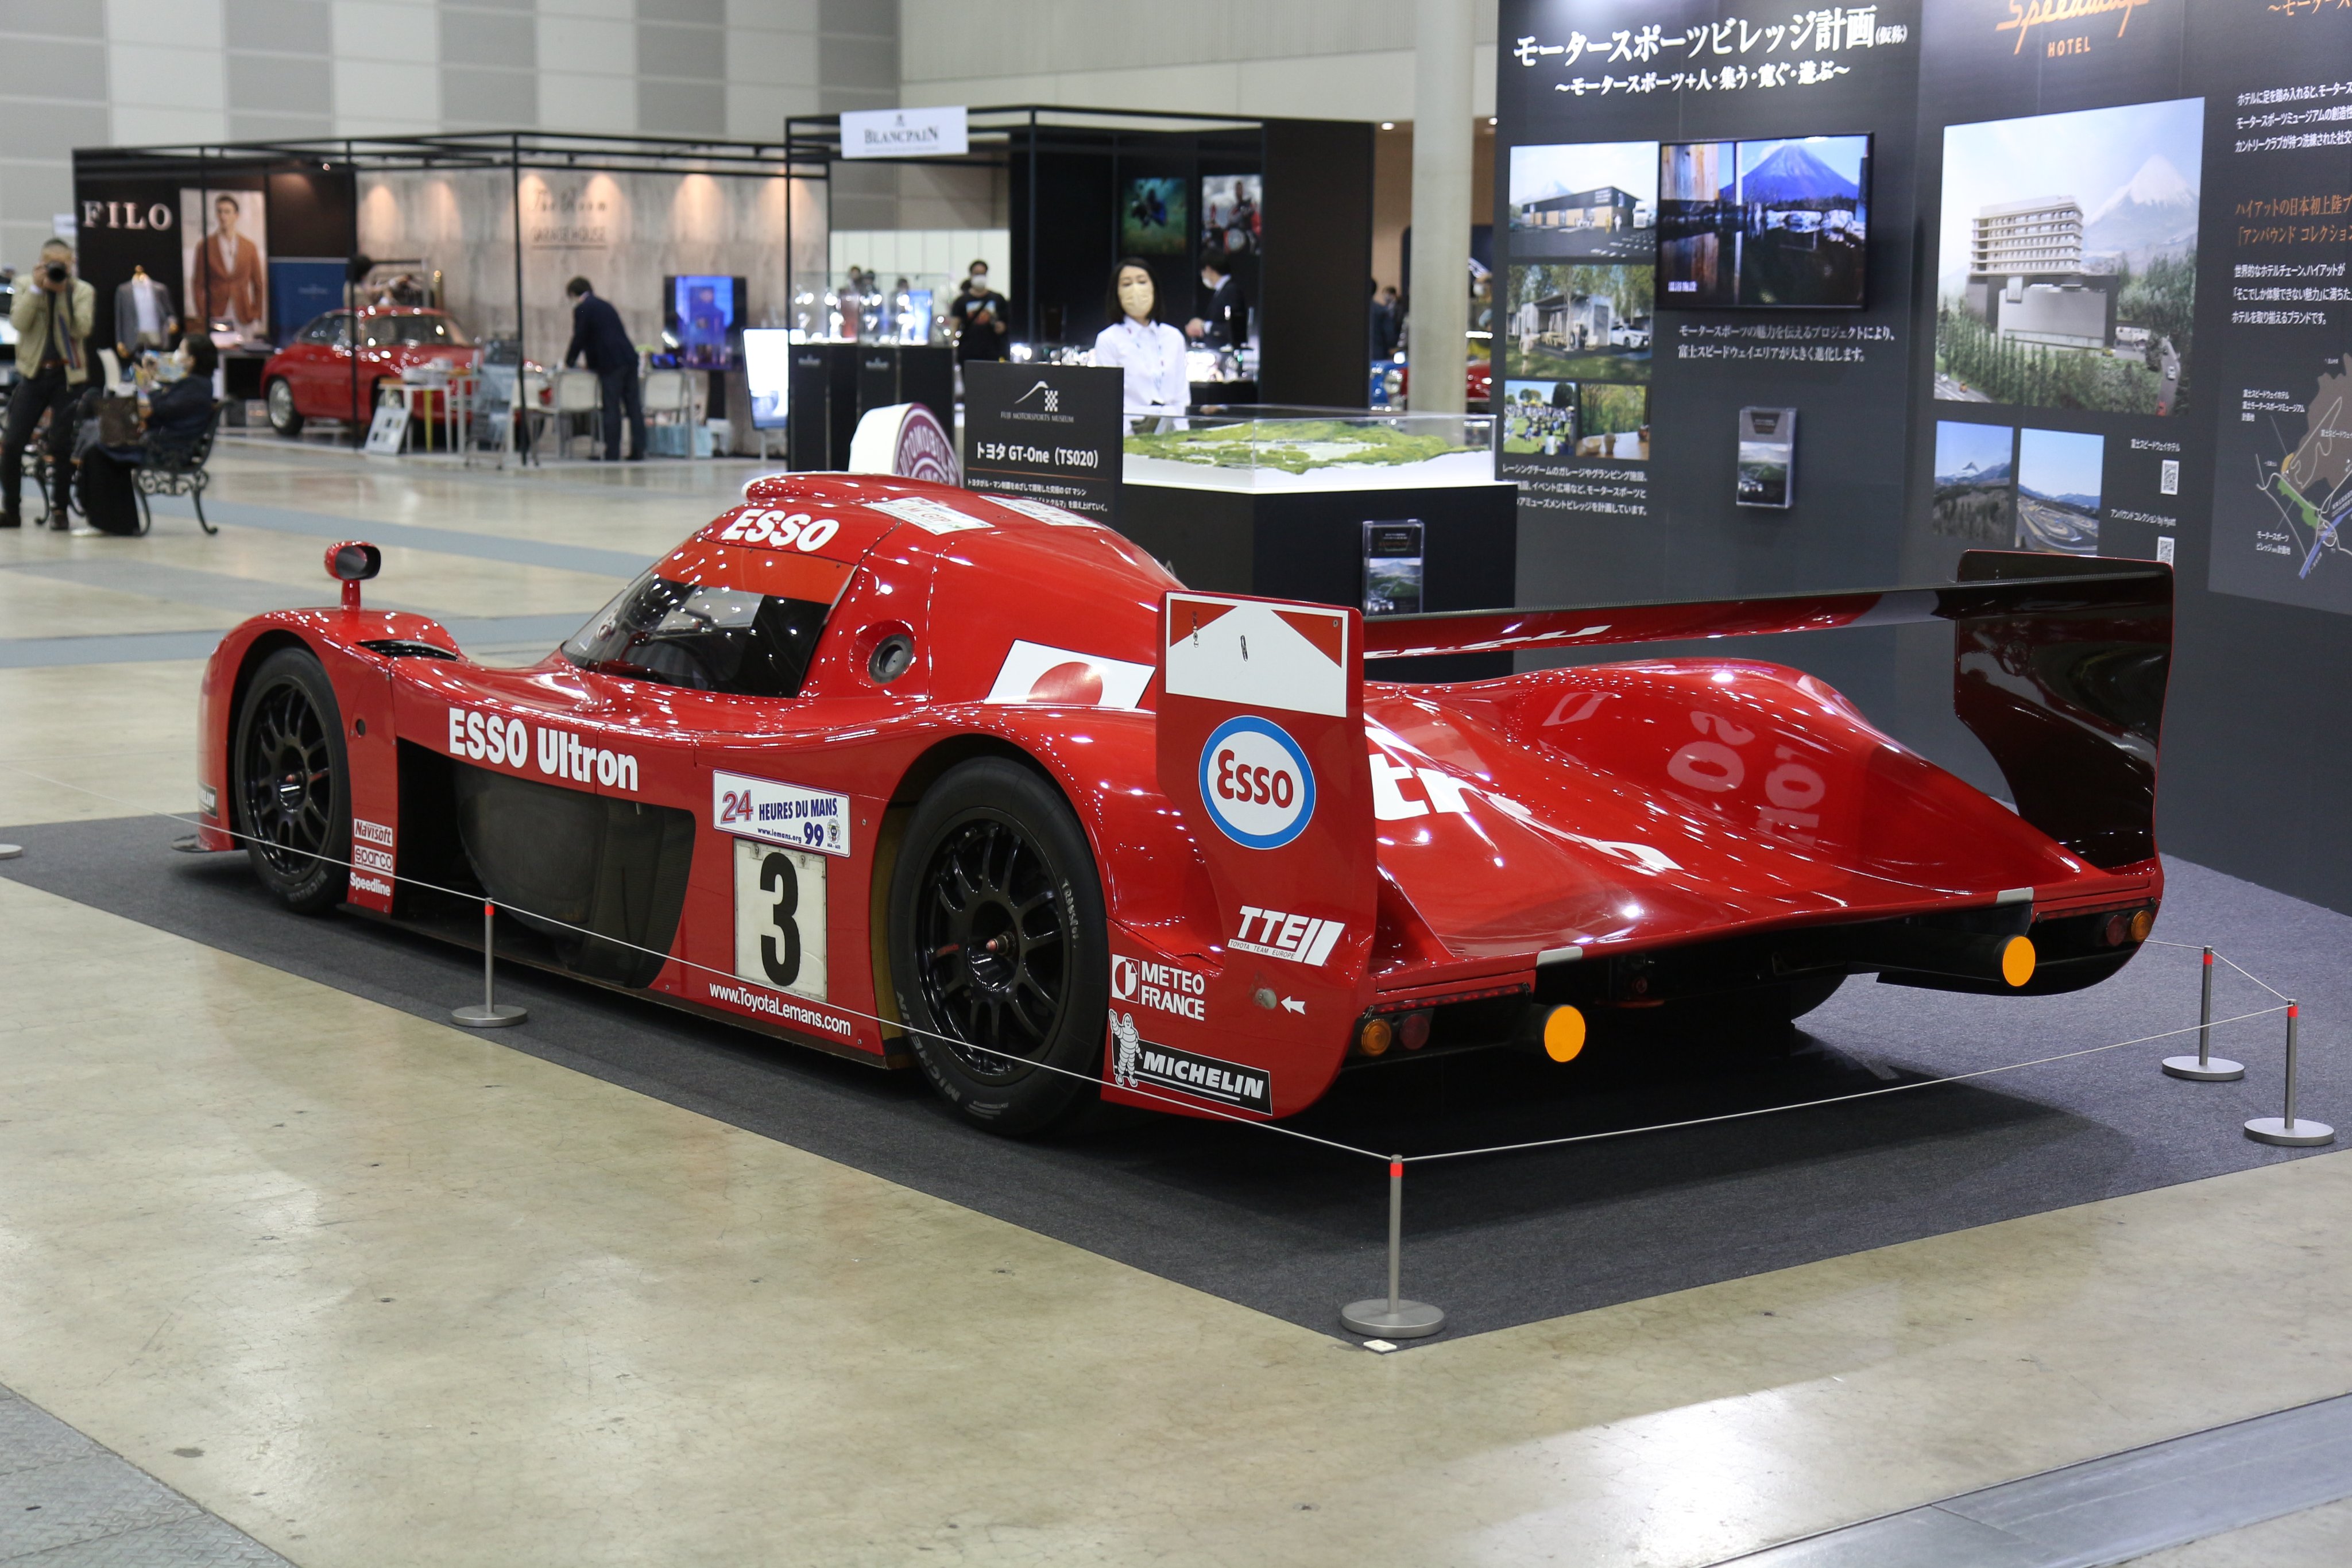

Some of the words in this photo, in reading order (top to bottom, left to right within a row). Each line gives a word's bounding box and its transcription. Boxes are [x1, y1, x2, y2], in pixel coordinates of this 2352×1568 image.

[2048, 36, 2091, 58] HOTEL
[82, 200, 173, 231] FILO
[977, 442, 1005, 460] トヨタ
[1008, 445, 1049, 463] GT-One
[722, 509, 840, 552] ESSO
[449, 707, 528, 768] ESSO
[537, 727, 639, 792] Ultron
[721, 789, 754, 824] 24
[759, 802, 793, 821] HEURES
[795, 800, 808, 818] DU
[811, 797, 838, 817] MANS
[355, 820, 392, 843] Navisoft
[757, 827, 802, 843] www.lemans.org
[804, 822, 824, 846] 99
[355, 847, 392, 869] sparco
[350, 872, 391, 896] Speedline
[760, 852, 800, 986] 3
[1230, 940, 1250, 950] TOYOTA
[1254, 946, 1269, 954] TEAM
[1272, 949, 1295, 959] EUROPE
[1141, 961, 1205, 996] METEO
[709, 983, 851, 1036] www.ToyotaLemans.com
[1141, 986, 1205, 1021] FRANCE
[1143, 1050, 1264, 1099] MICHELIN
